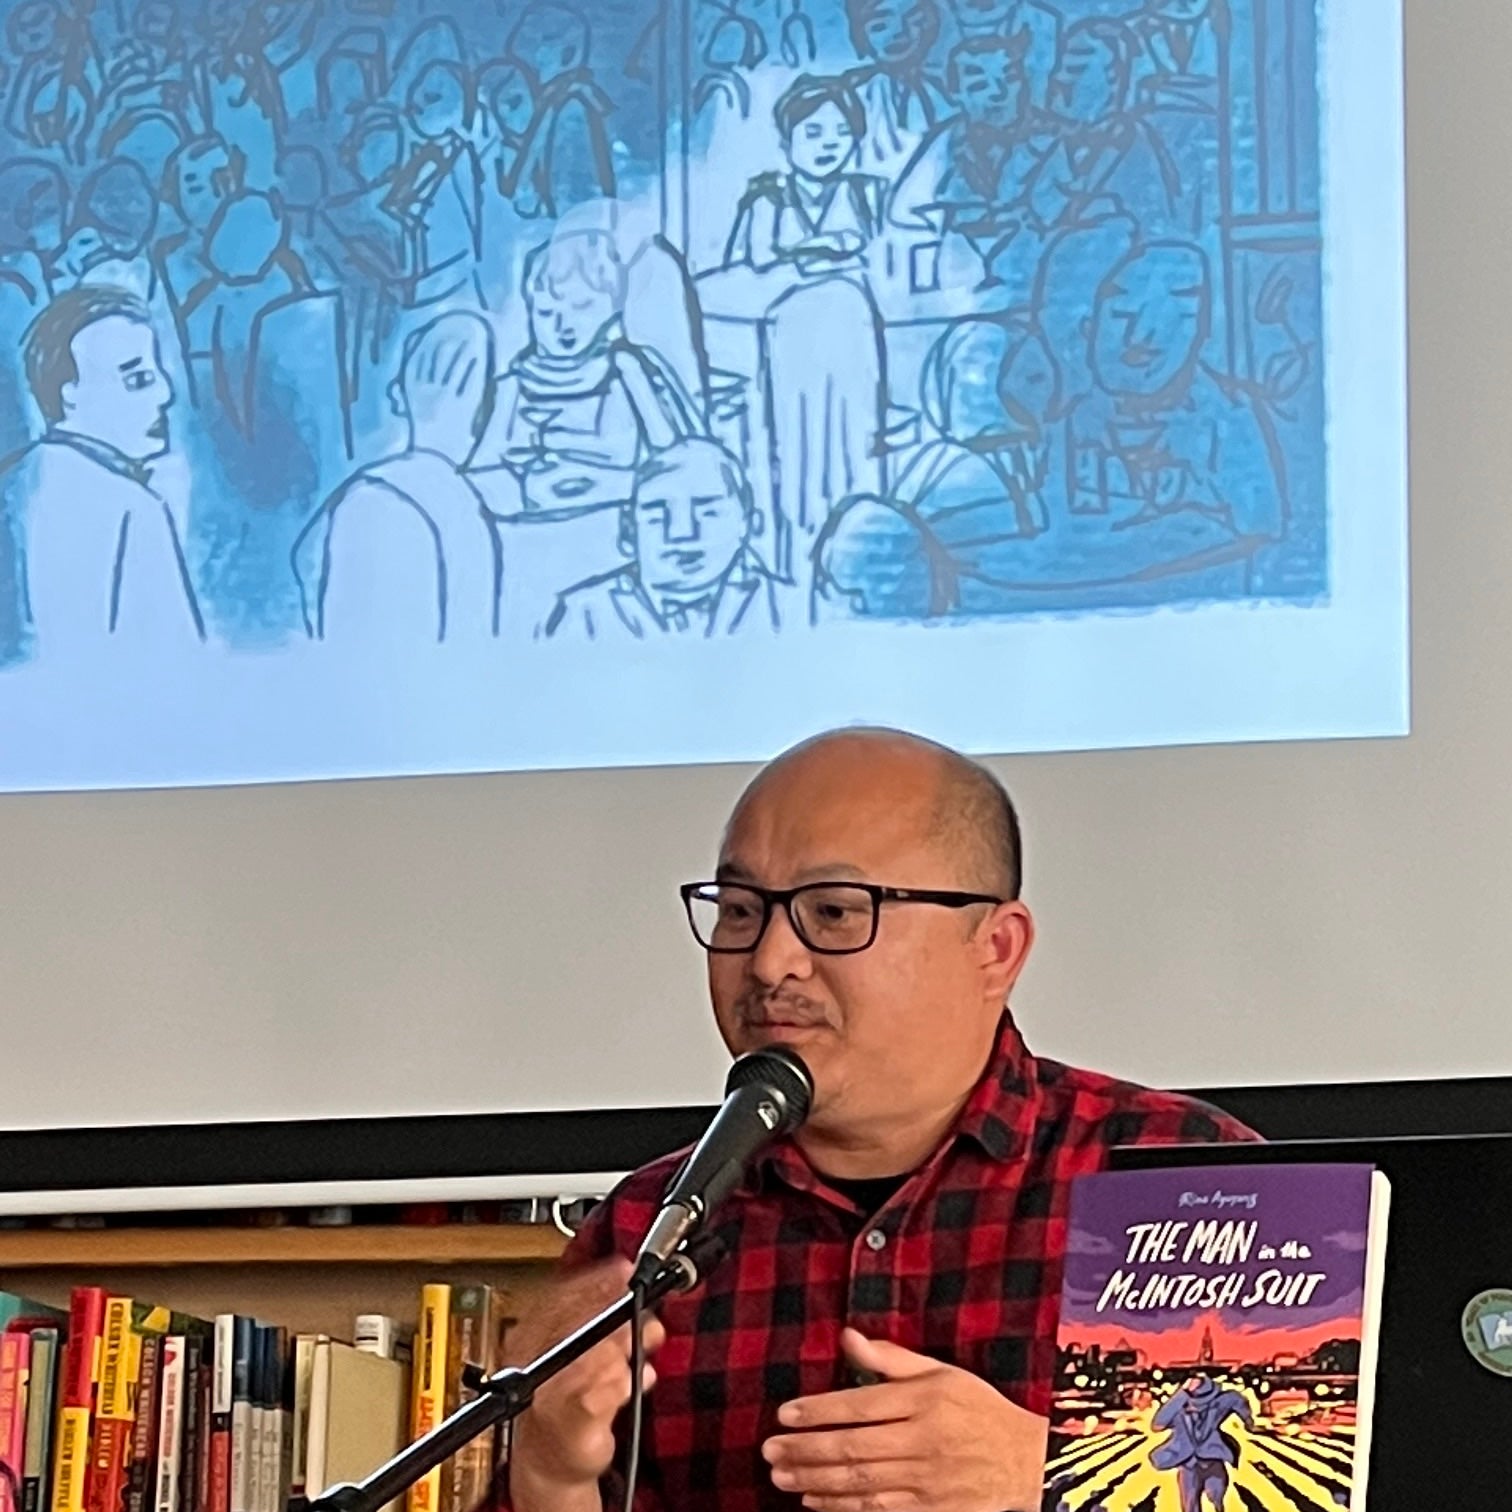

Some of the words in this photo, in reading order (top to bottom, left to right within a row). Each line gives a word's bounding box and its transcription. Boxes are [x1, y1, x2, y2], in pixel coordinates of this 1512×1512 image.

[1126, 1222, 1189, 1264] THE
[1182, 1220, 1258, 1265] MAN
[1258, 1244, 1276, 1260] in
[1280, 1240, 1312, 1260] the
[1096, 1270, 1254, 1312] McINTOSH
[1243, 1269, 1326, 1307] SUIT
[108, 1302, 125, 1350] COLSON
[101, 1352, 119, 1416] WHITEHEAD
[140, 1338, 155, 1386] COLSON
[134, 1389, 152, 1459] WHITEHEAD
[414, 1479, 430, 1511] SPY
